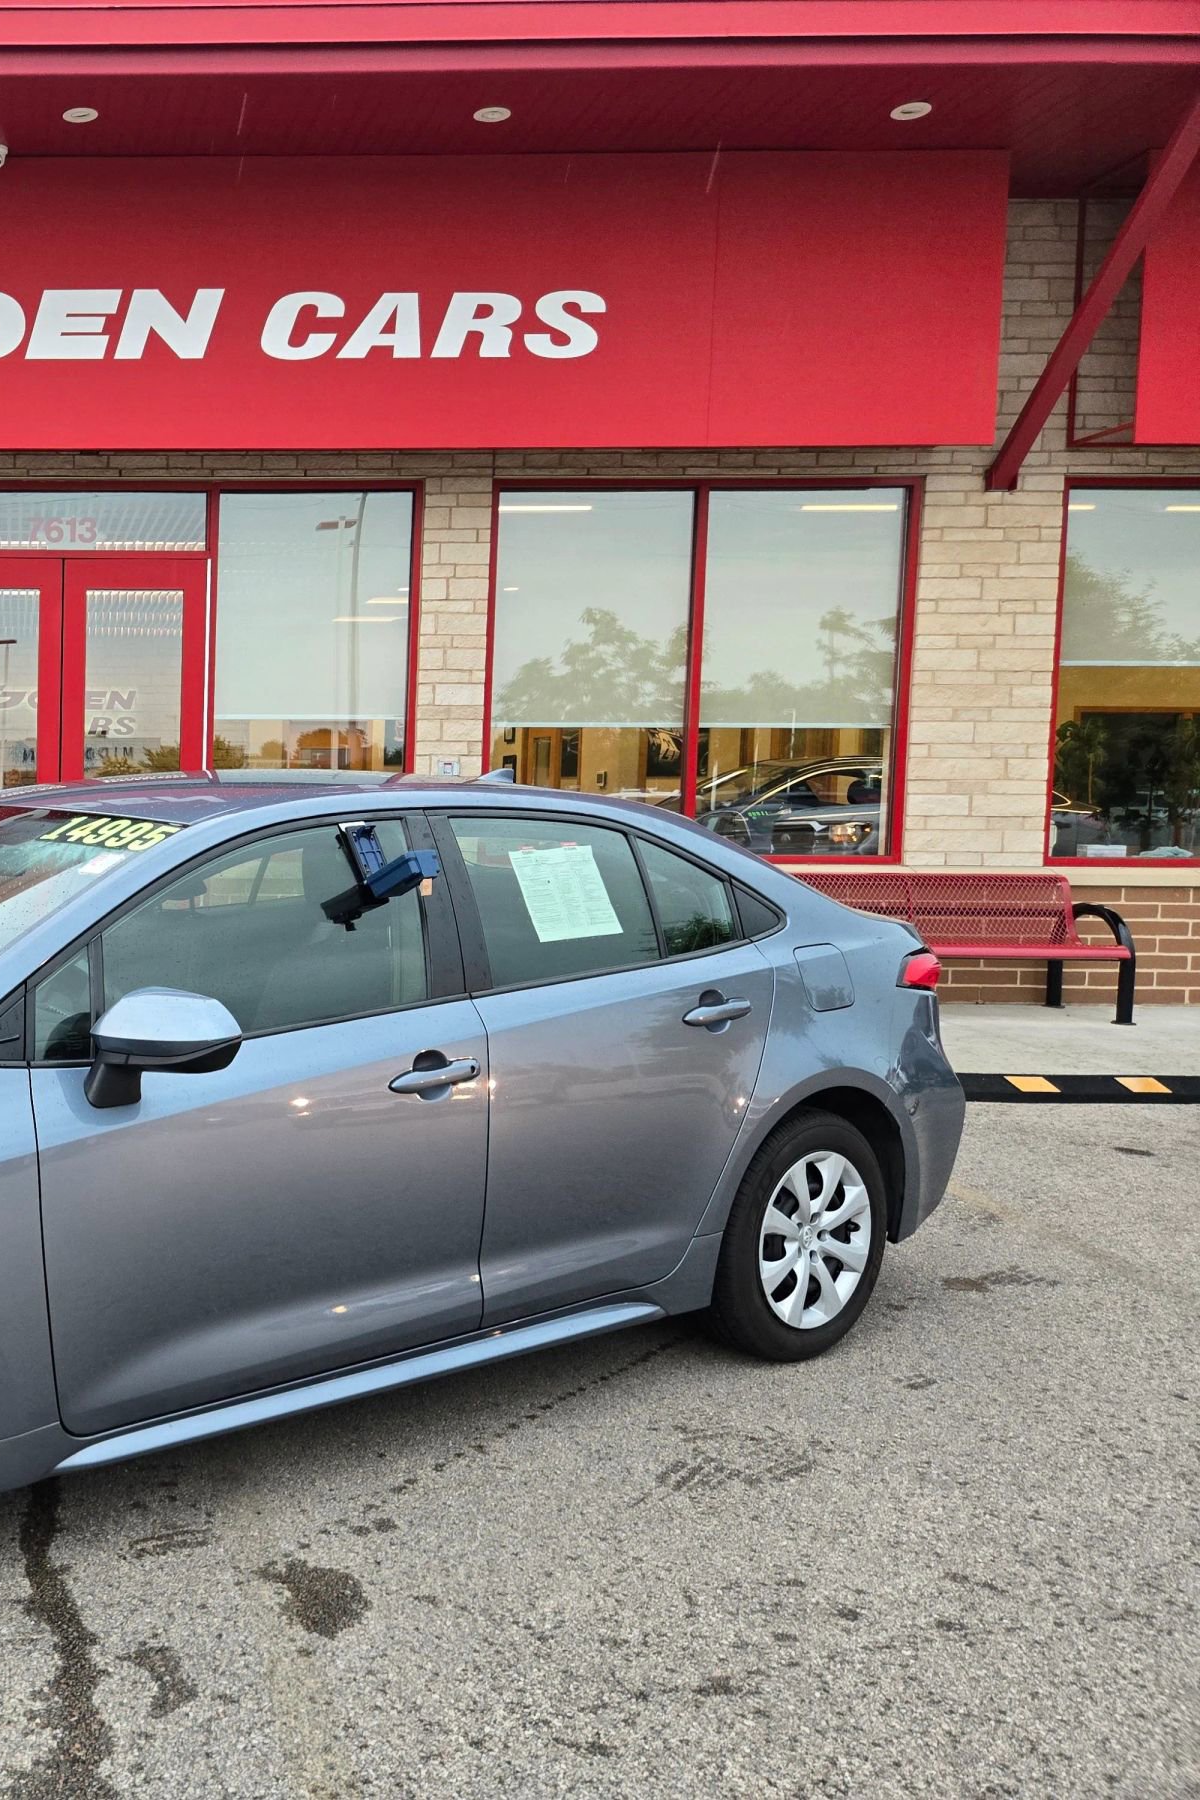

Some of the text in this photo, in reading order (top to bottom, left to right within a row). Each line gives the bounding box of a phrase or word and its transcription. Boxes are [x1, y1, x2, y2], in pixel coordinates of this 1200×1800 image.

[260, 290, 608, 361] CARS
[28, 517, 98, 544] 7613
[39, 815, 182, 852] 14995
